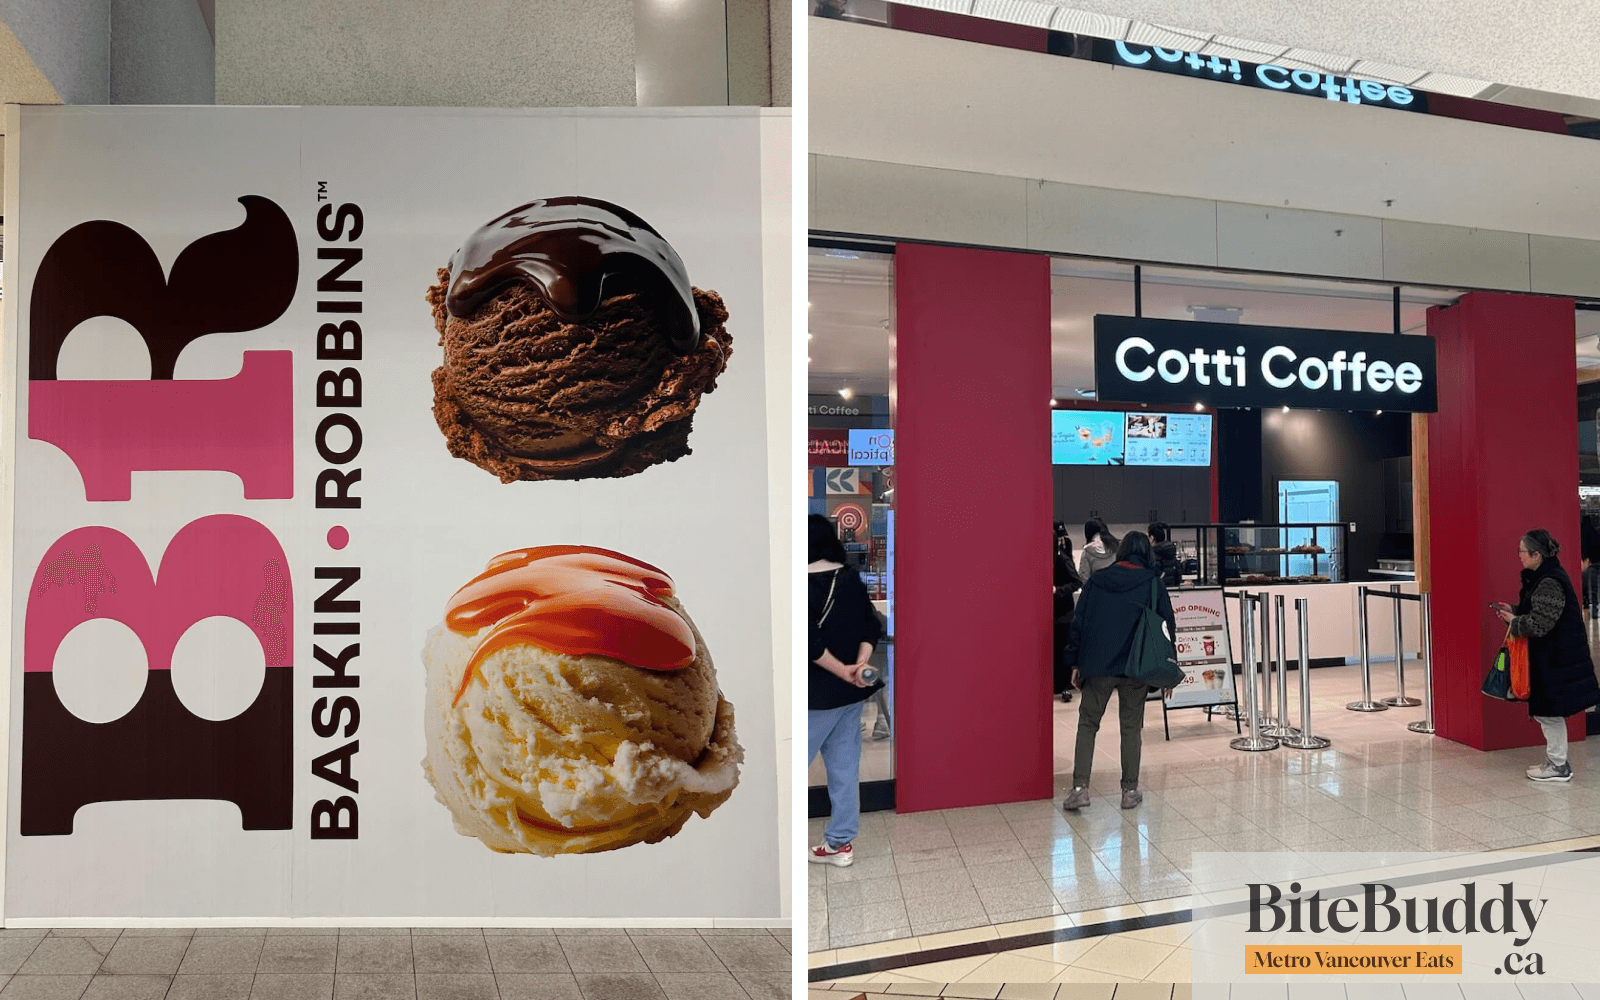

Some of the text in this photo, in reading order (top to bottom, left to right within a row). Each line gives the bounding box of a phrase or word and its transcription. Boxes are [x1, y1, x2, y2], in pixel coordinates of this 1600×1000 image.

[1115, 336, 1423, 394] Cotti Coffee
[819, 405, 860, 416] Coffee
[1188, 605, 1221, 618] OPENING
[1177, 643, 1191, 653] 0%
[311, 566, 361, 840] BASKIN
